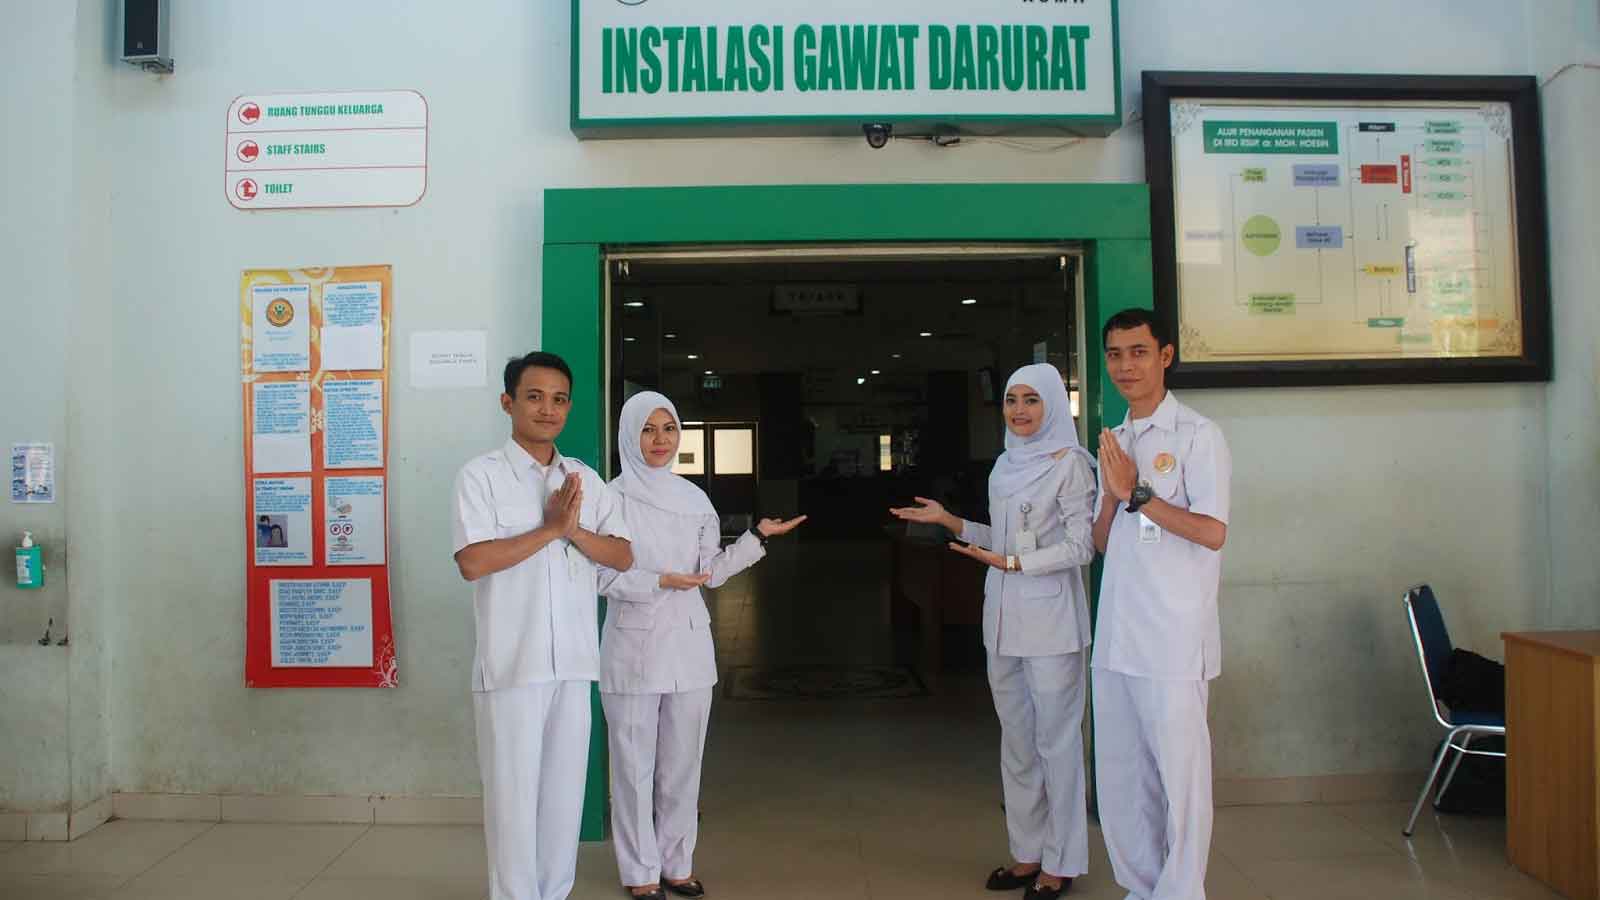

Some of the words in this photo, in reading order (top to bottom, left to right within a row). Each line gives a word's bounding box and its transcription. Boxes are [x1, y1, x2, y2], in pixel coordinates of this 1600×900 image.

[602, 24, 784, 94] INSTALASI
[794, 24, 920, 92] GAWAT
[928, 24, 1091, 91] DARURAT
[267, 106, 298, 117] RUANG
[300, 105, 336, 117] TUNGGU
[338, 103, 384, 116] KELUARGA
[266, 144, 293, 155] STAFF
[294, 143, 326, 154] STAIRS
[264, 183, 294, 194] TOILET
